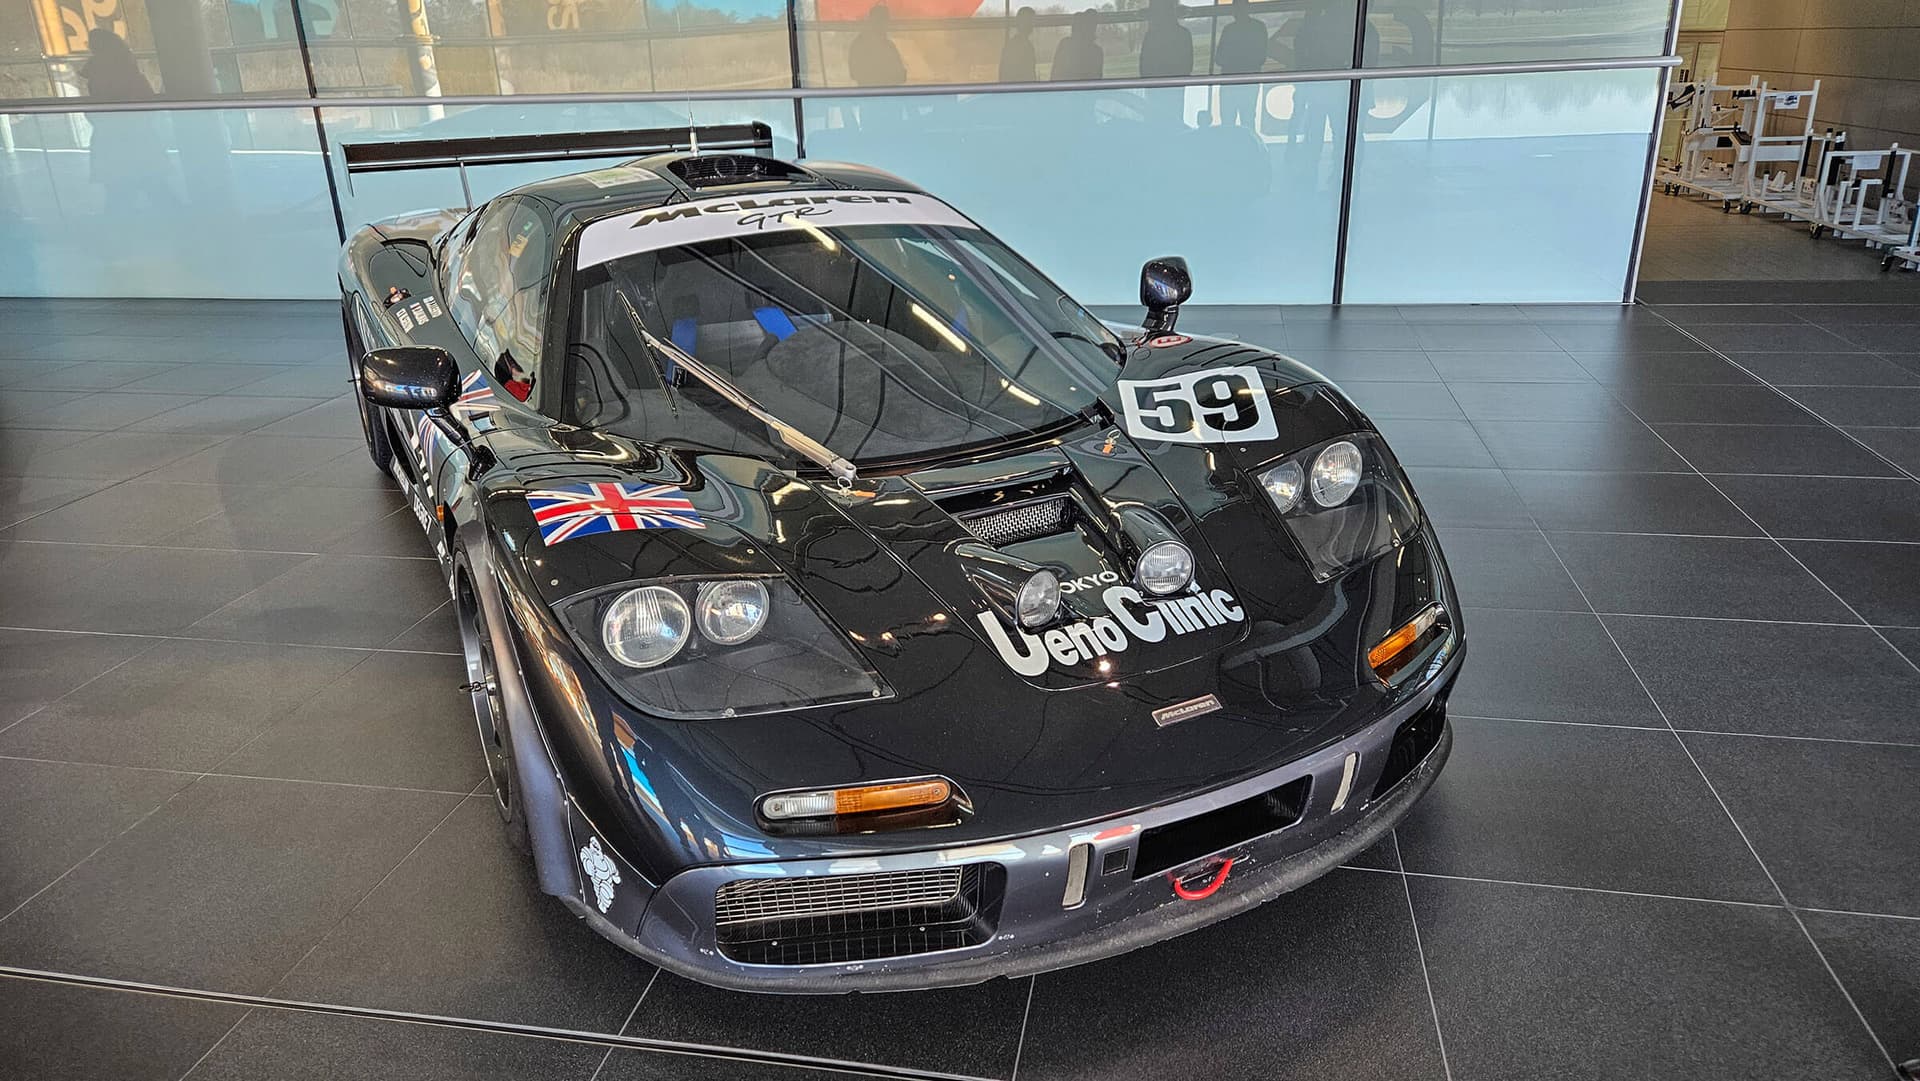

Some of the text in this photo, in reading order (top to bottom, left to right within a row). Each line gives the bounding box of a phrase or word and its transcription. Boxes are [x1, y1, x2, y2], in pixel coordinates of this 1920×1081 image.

[630, 195, 912, 229] McLaren
[737, 206, 832, 230] GTR
[1133, 374, 1260, 433] 59
[1059, 571, 1119, 594] OKYO
[976, 580, 1245, 677] Ueno Clinic
[1160, 699, 1215, 721] McLaren
